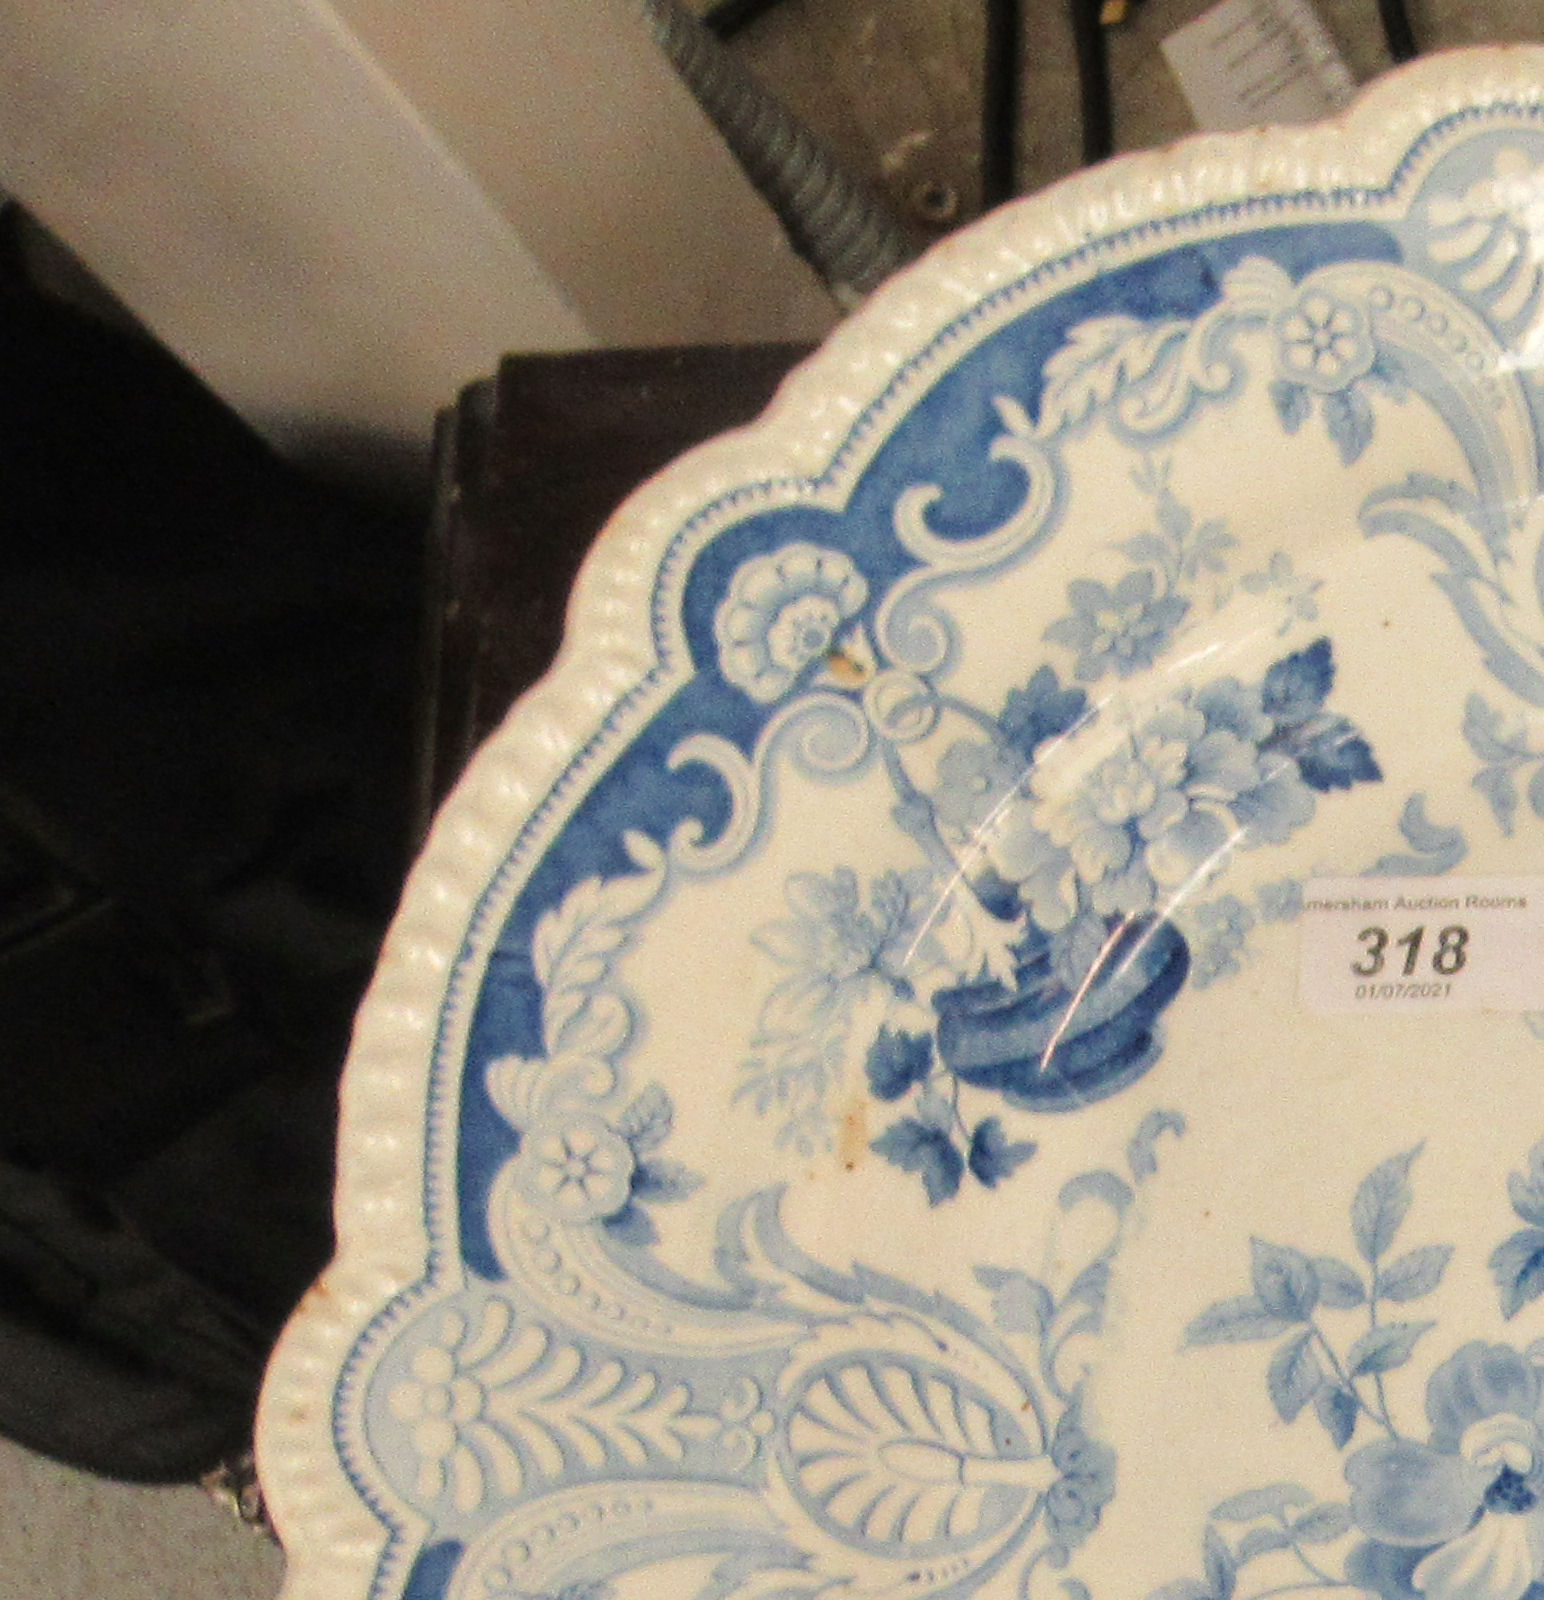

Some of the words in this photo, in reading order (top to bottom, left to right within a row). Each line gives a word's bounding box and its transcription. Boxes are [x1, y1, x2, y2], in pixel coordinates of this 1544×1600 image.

[1303, 896, 1390, 910] mersham
[1394, 896, 1459, 910] Auction
[1465, 895, 1527, 909] Rooms
[1352, 925, 1469, 977] 318
[1355, 983, 1451, 999] 01/07/2021
